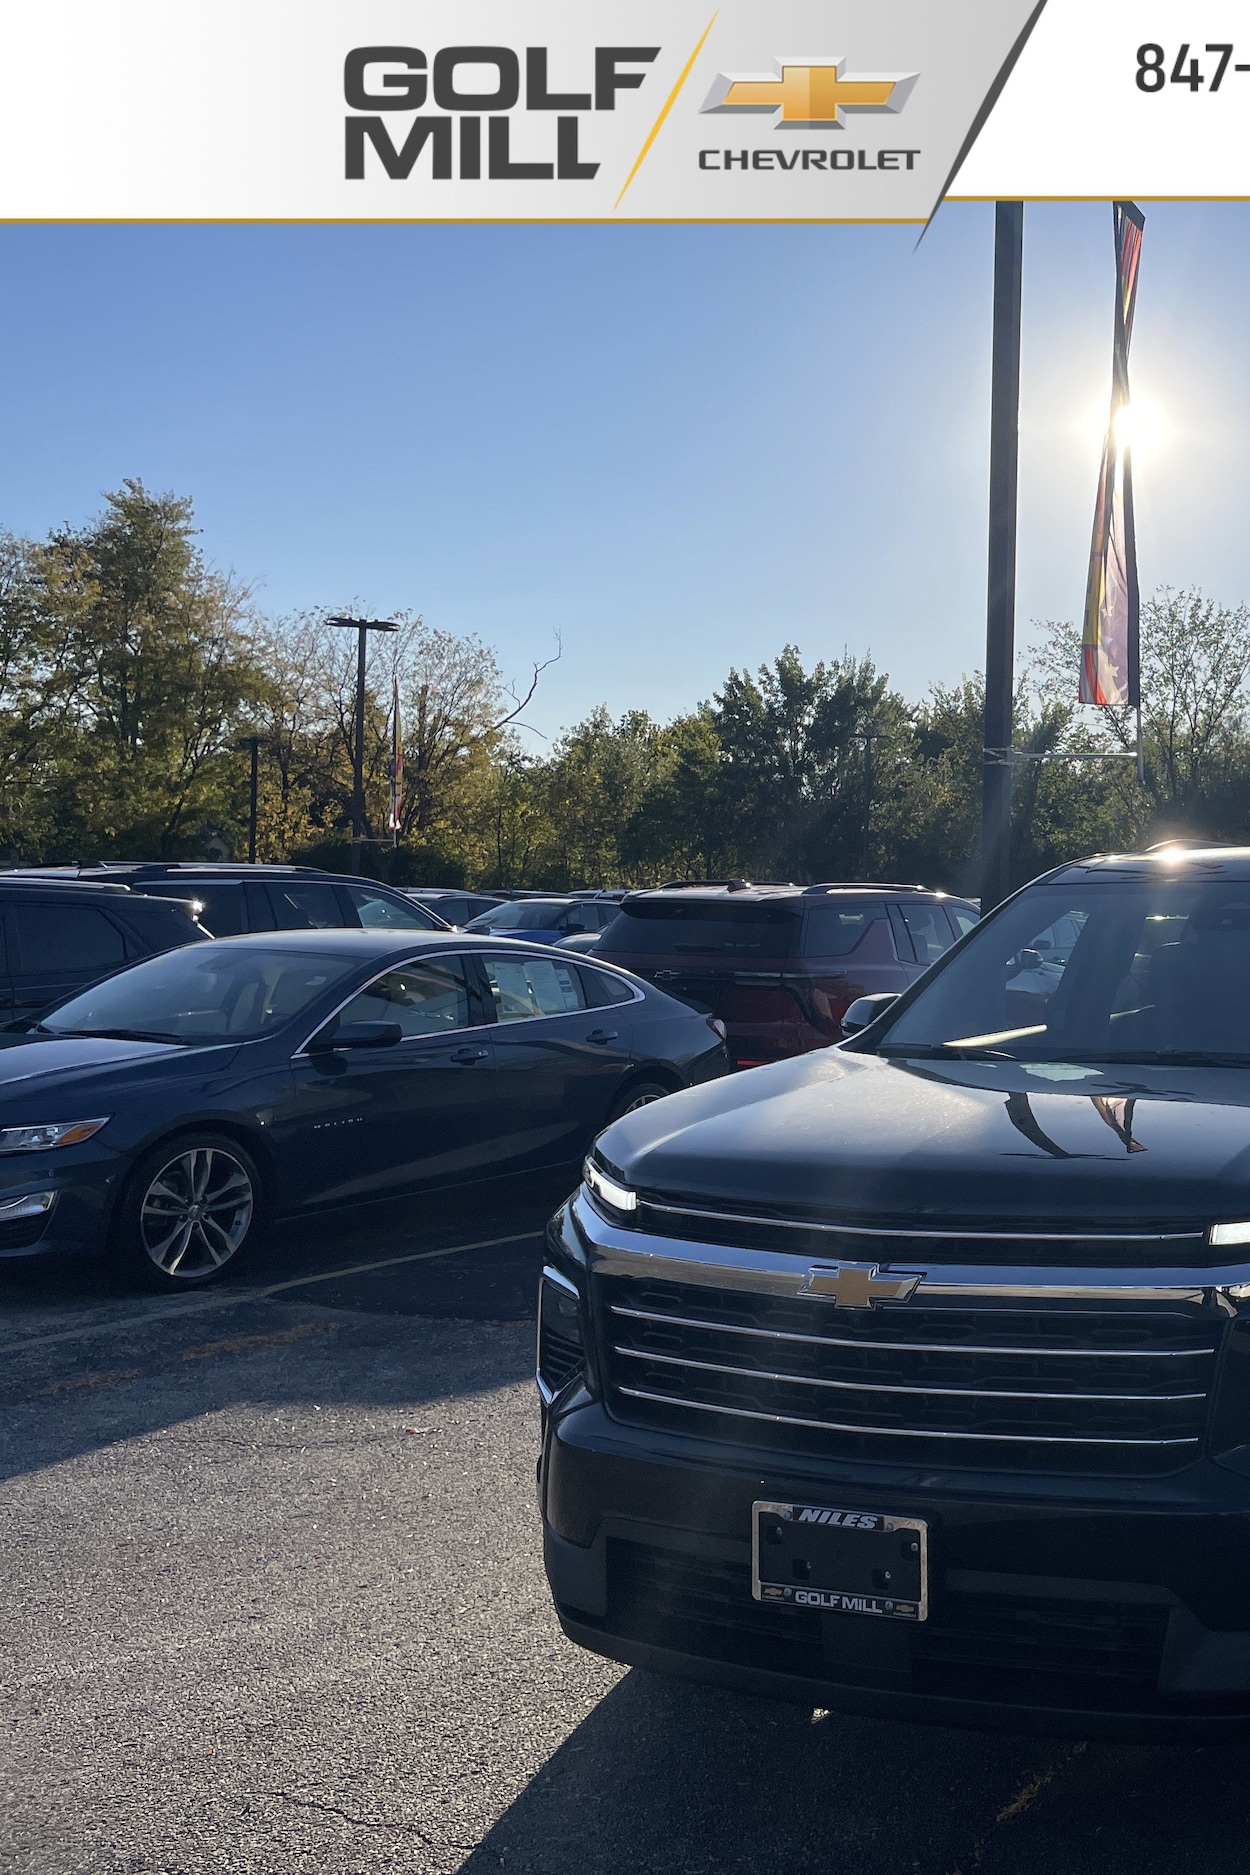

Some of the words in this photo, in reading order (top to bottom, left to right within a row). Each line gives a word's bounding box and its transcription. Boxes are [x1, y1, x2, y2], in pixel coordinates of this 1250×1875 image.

[798, 1508, 878, 1530] NILES
[795, 1590, 840, 1608] GOLF
[842, 1596, 883, 1614] MILL
